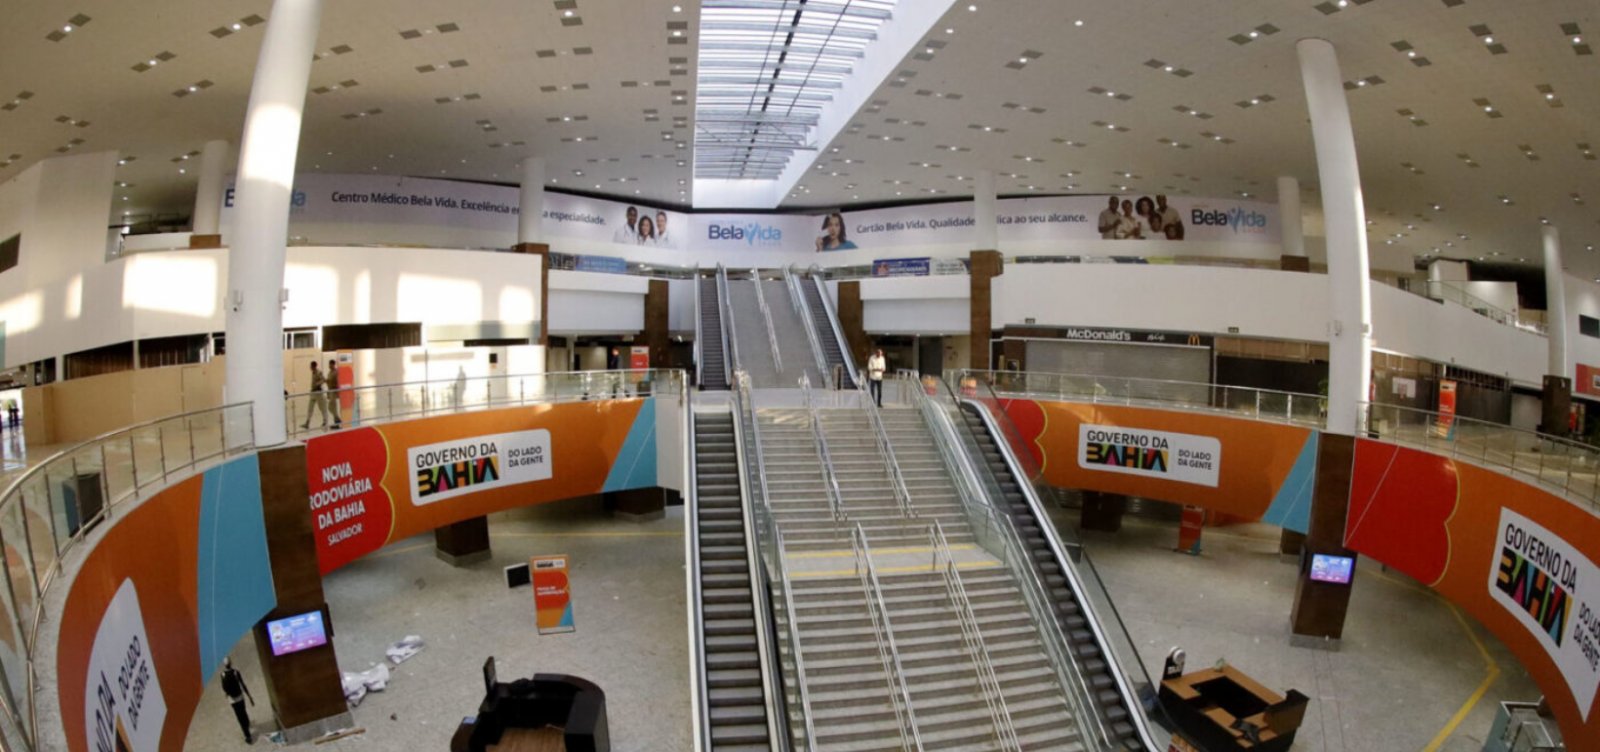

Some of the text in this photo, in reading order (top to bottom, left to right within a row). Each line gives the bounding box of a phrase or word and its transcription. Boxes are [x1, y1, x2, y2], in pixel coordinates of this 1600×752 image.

[331, 191, 369, 203] Centro
[370, 193, 409, 205] Médico
[411, 195, 433, 207] Bela
[434, 197, 459, 209] Vida.
[461, 199, 510, 214] Excelência
[549, 210, 606, 226] especialidade.
[856, 223, 885, 234] Cartão
[886, 221, 905, 231] Bela
[906, 219, 927, 229] Vida.
[929, 217, 976, 229] Qualidade
[1014, 215, 1027, 224] ao
[1028, 215, 1047, 223] seu
[1048, 213, 1088, 222] alcance.
[1066, 329, 1131, 341] McDonald's
[1087, 430, 1169, 449] GOVERNO DA
[416, 442, 498, 468] GOVERNO DA
[508, 446, 542, 458] DO LADO
[508, 455, 543, 468] DA GENTE
[1178, 449, 1211, 460] DO LADO
[322, 462, 353, 484] NOVA
[1178, 458, 1212, 470] DA GENTE
[318, 500, 366, 530] DA BAHIA
[328, 522, 363, 546] SALVADOR
[1505, 523, 1577, 594] GOVERNO DA
[1579, 602, 1591, 625] DO
[1573, 623, 1583, 646] DA
[118, 635, 141, 702] DO LADO
[98, 669, 116, 735] DA
[128, 659, 149, 731] DA GENTE
